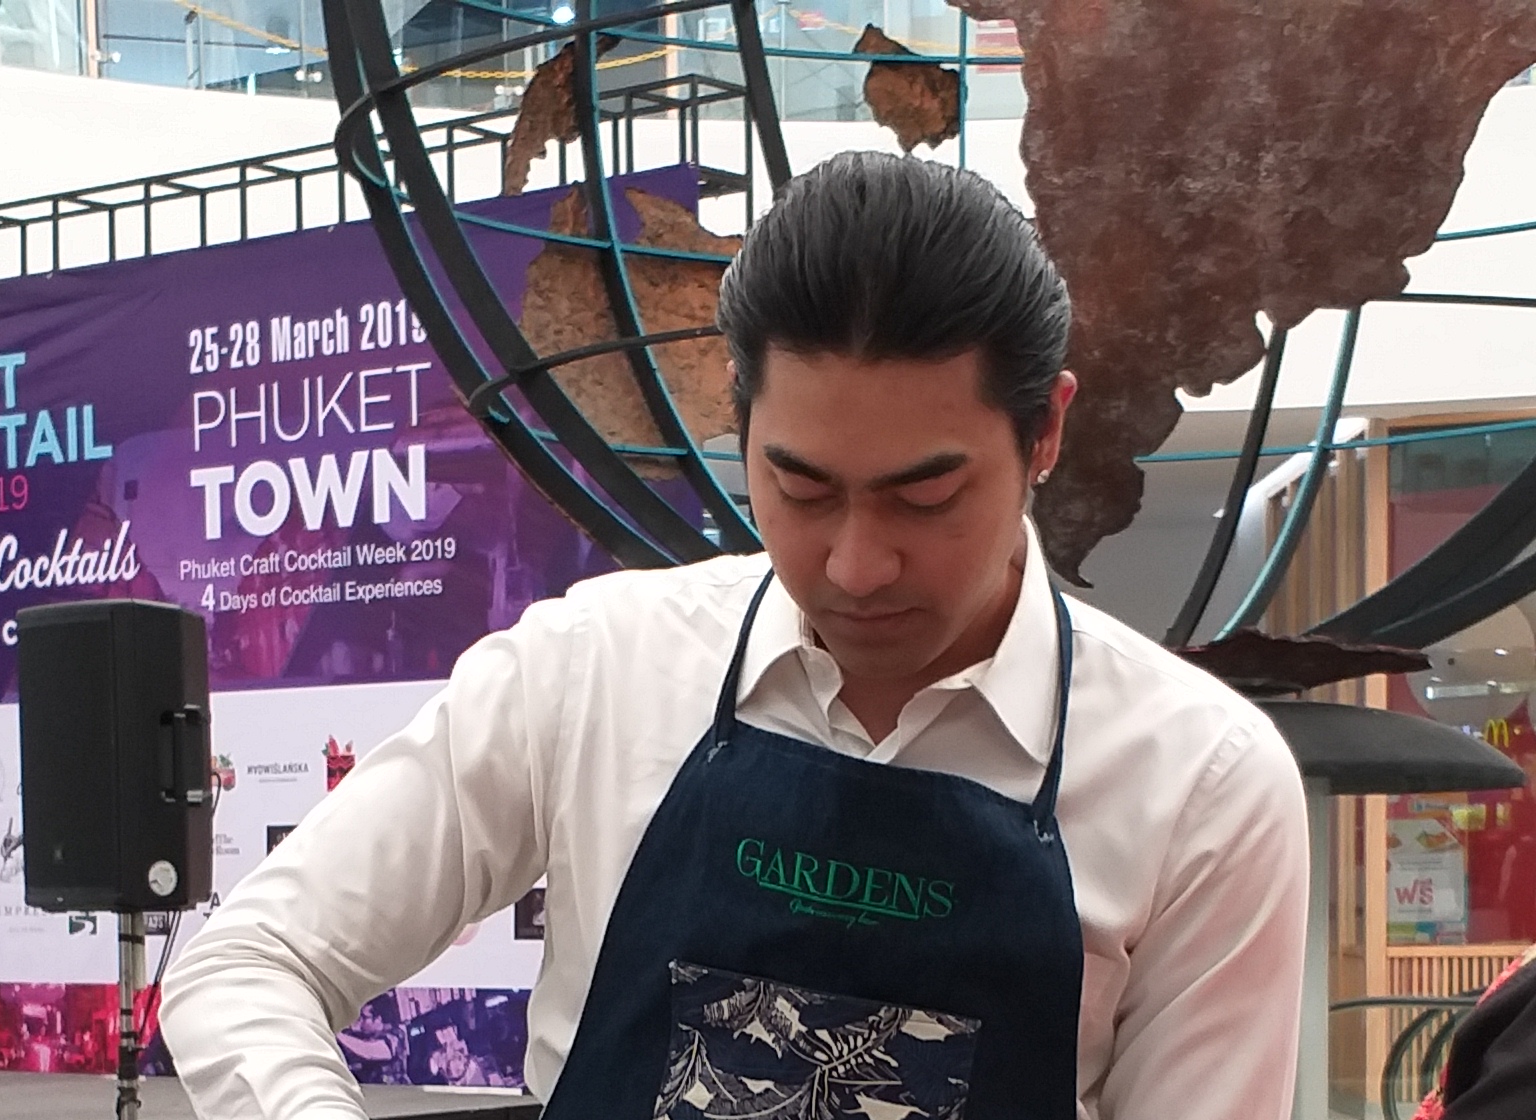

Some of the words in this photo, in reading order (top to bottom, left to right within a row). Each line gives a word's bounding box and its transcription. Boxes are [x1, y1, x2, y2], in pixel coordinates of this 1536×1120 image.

[189, 321, 261, 375] 25-28
[270, 306, 350, 363] March
[193, 362, 432, 452] PHUKET
[189, 443, 426, 541] TOWN
[179, 557, 236, 581] Phuket
[239, 551, 281, 577] Craft
[284, 545, 352, 571] Cocktail
[355, 541, 407, 566] Week
[410, 537, 456, 562] 2019
[200, 583, 216, 612] 4
[219, 590, 258, 613] Days
[261, 588, 277, 607] of
[279, 582, 341, 607] Cocktail
[344, 577, 443, 605] Experiences
[735, 837, 956, 918] GARDENS
